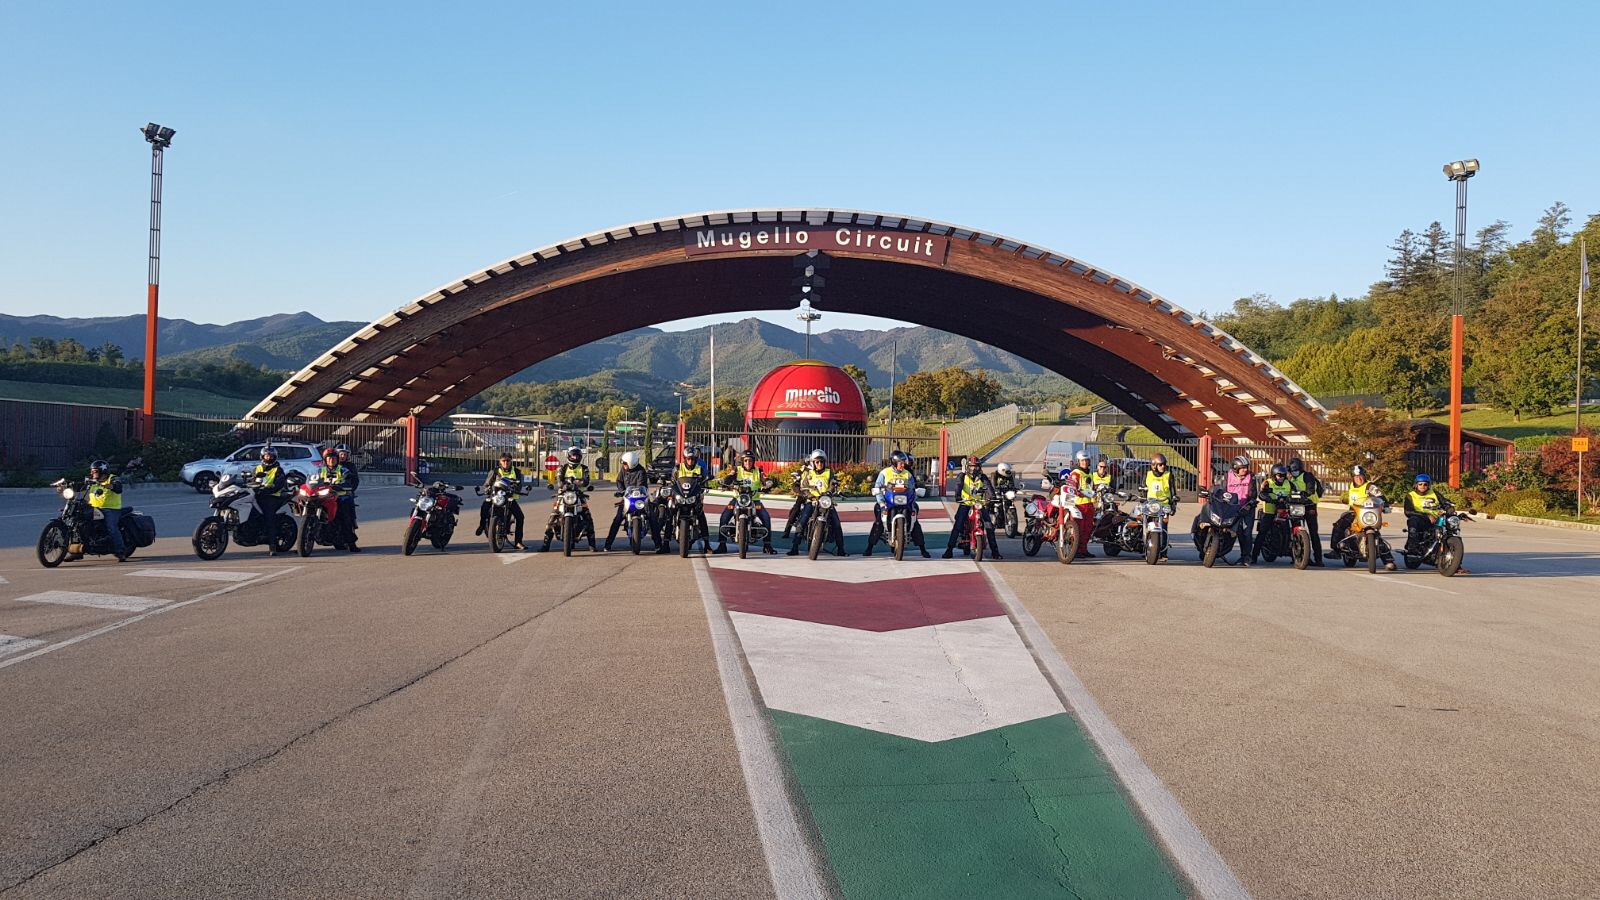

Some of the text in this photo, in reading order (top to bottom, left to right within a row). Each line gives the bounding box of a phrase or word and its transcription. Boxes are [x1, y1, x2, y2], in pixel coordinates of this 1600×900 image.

[696, 226, 934, 256] Mugello Circuit
[785, 386, 841, 404] mugello
